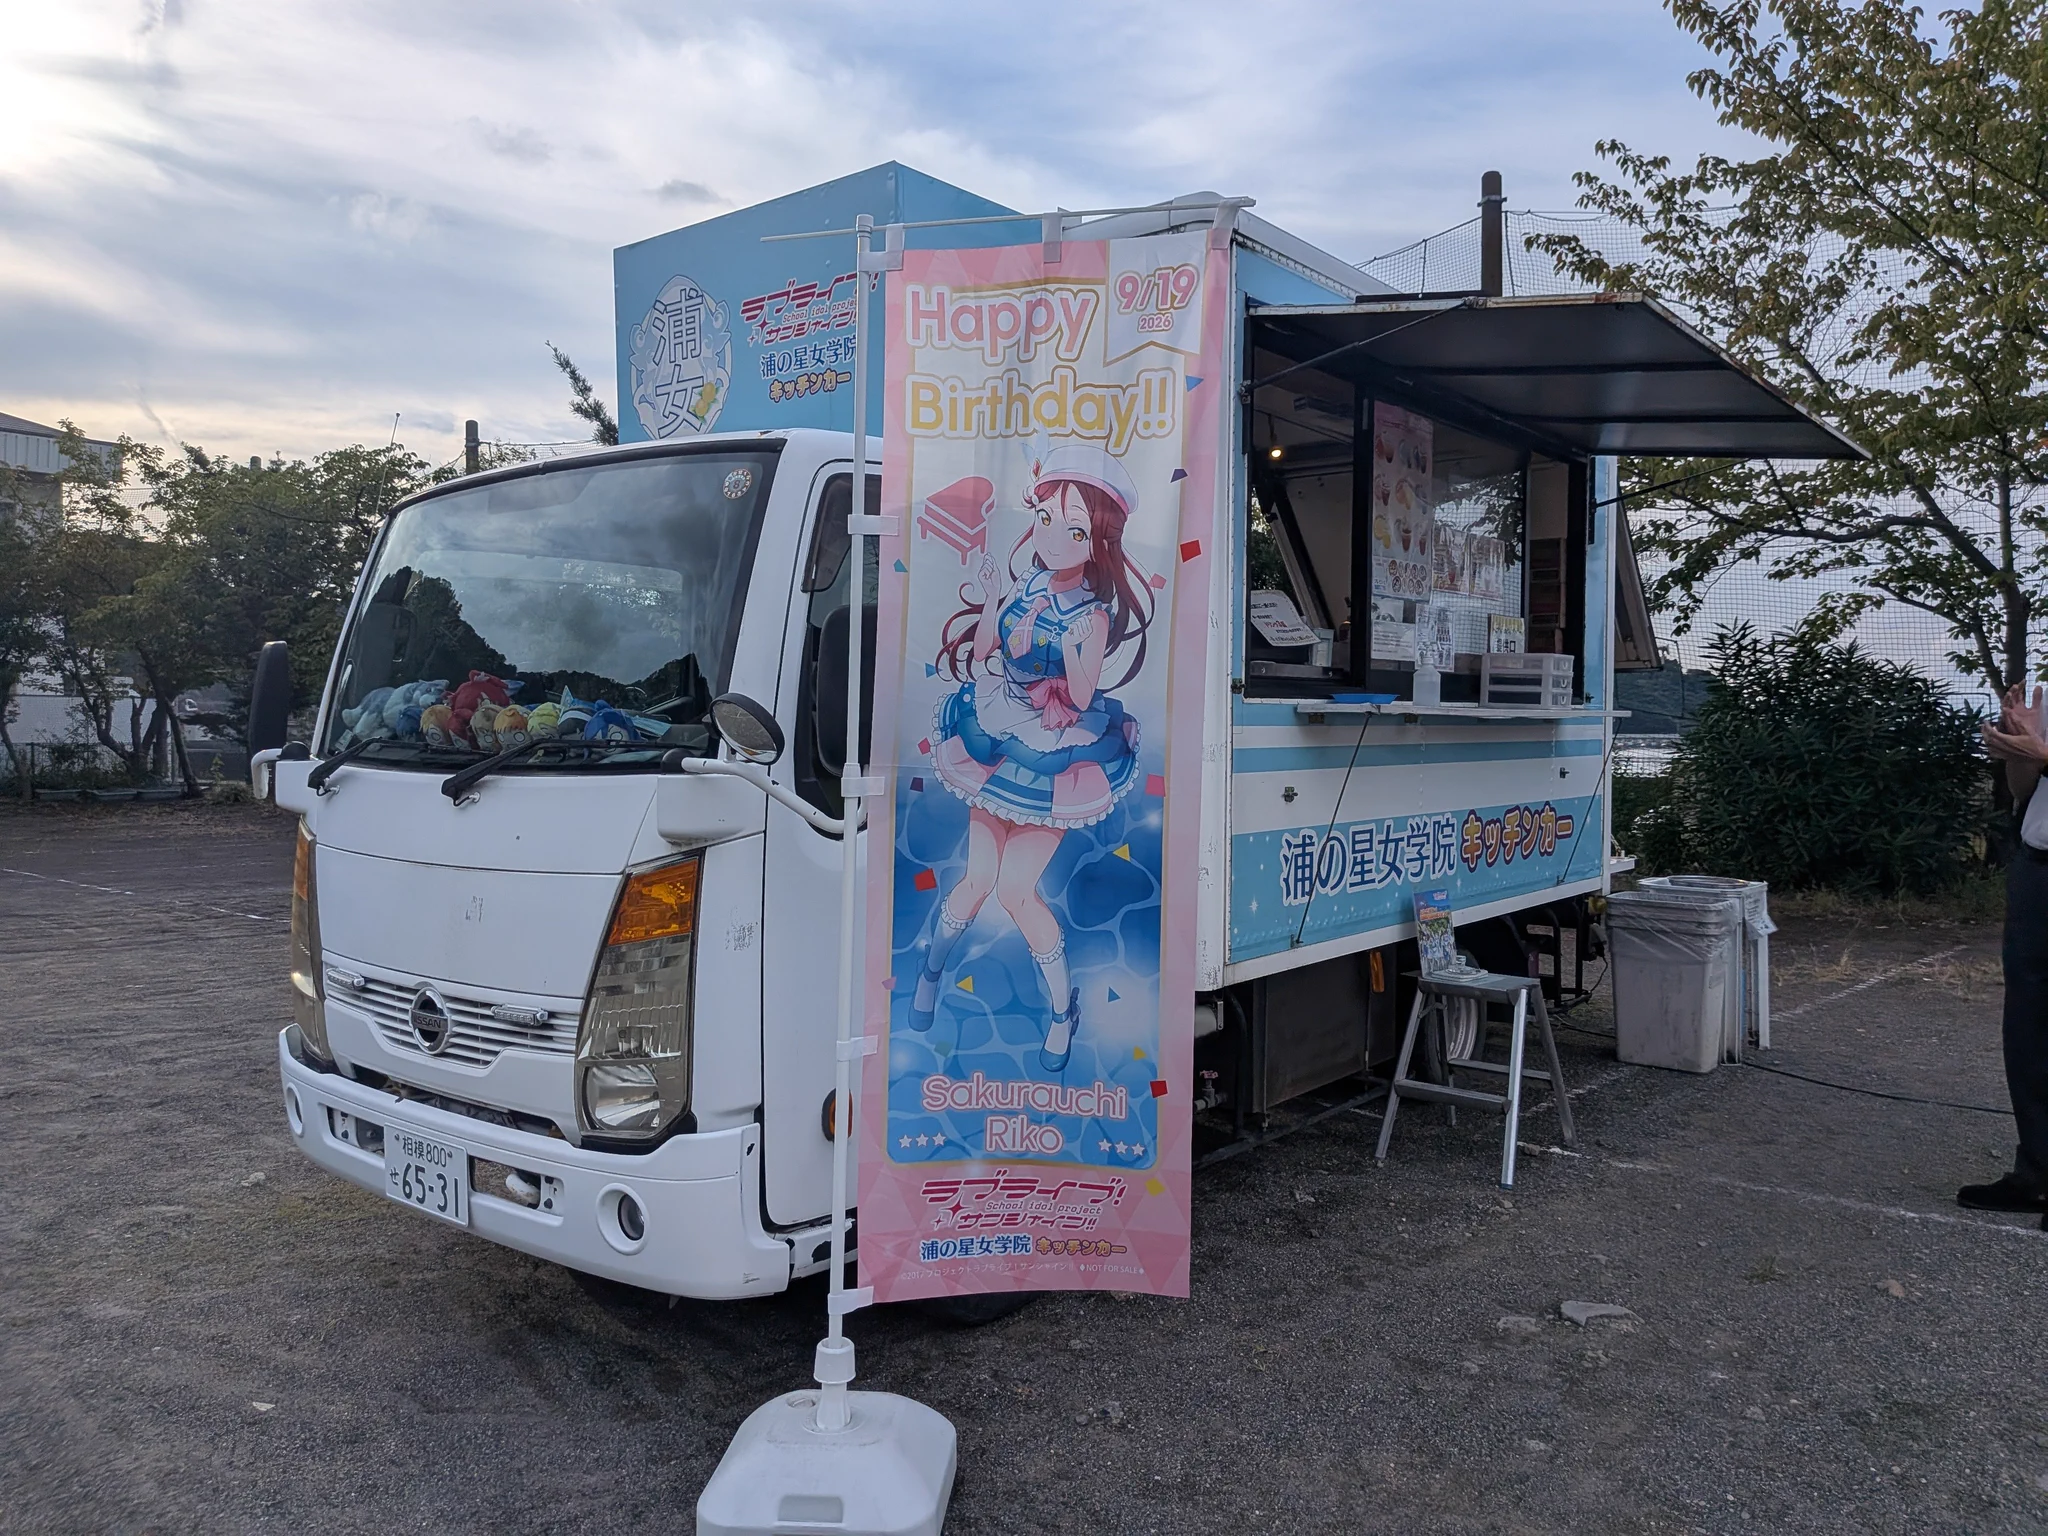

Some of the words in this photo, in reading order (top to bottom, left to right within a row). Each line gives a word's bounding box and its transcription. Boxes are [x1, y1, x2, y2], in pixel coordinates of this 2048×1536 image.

[1117, 267, 1197, 312] 9/19
[764, 310, 857, 345] サンシャイン!
[782, 310, 808, 323] School
[811, 304, 829, 317] idol
[832, 296, 857, 313] proje
[909, 288, 1095, 361] Happy
[1139, 315, 1172, 331] 2026
[652, 288, 705, 440] 浦女
[768, 368, 852, 403] キッチンカー
[910, 373, 1169, 450] Birthday!!
[1282, 817, 1456, 901] 浦の星女学院
[1461, 801, 1574, 873] キッチンカー
[922, 1072, 1128, 1120] Sakurauchi
[402, 1135, 447, 1168] 相模800
[986, 1115, 1063, 1154] Riko
[389, 1167, 399, 1186] せ
[402, 1162, 459, 1218] 65-31
[921, 1169, 1127, 1206] ラブライブ!
[957, 1212, 1098, 1231] サンシャイン!!
[986, 1201, 1023, 1211] School
[1029, 1201, 1053, 1212] idol
[1057, 1204, 1102, 1215] project
[920, 1234, 1032, 1261] 浦の星女学院
[1035, 1236, 1128, 1257] キッチンカー
[1086, 1263, 1102, 1272] NOT
[1103, 1264, 1119, 1273] FOR
[1119, 1265, 1138, 1274] SALE
